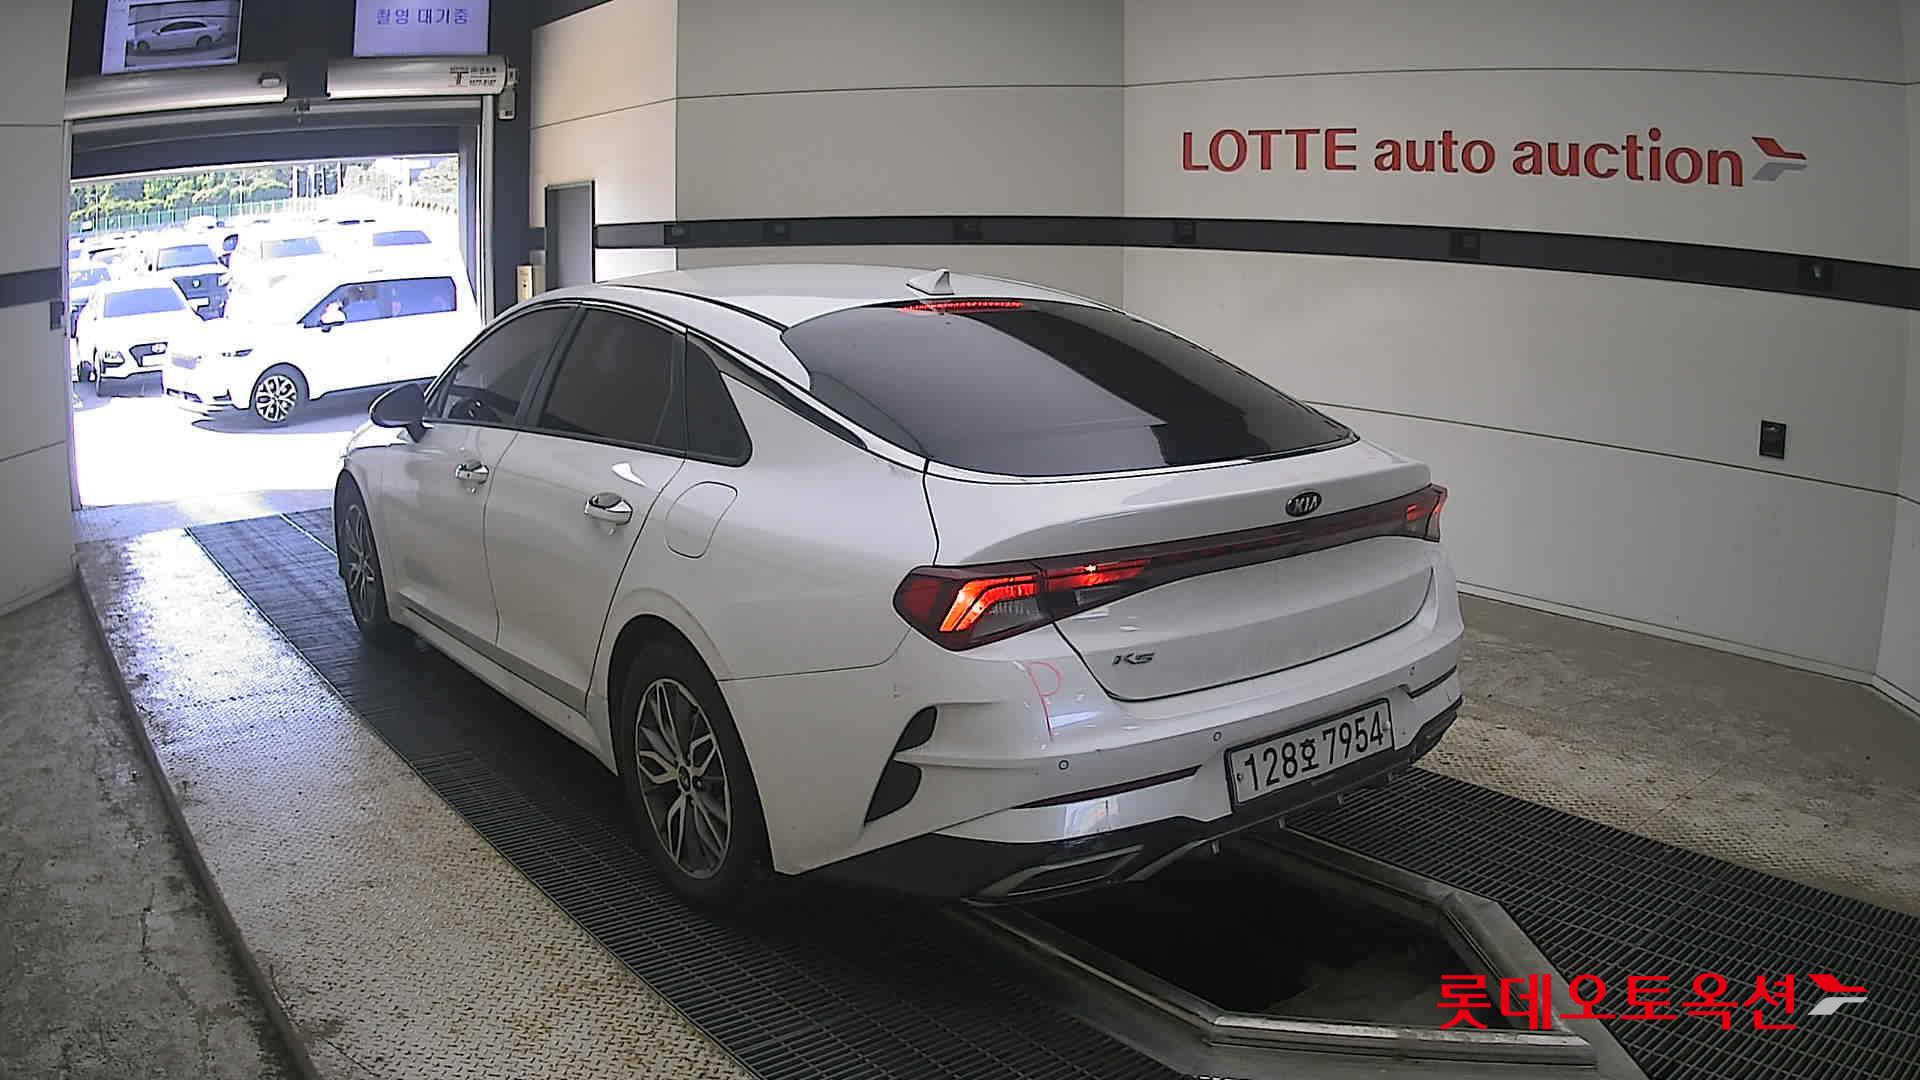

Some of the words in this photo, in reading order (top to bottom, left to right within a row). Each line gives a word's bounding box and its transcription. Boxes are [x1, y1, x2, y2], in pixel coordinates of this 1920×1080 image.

[417, 8, 468, 25] 대기중
[1182, 128, 1357, 172] LOTTE
[1374, 130, 1496, 173] auto
[1512, 127, 1744, 187] auction
[1293, 494, 1319, 513] KIA
[1112, 652, 1155, 666] K5
[1244, 738, 1320, 791] 128호
[1322, 711, 1384, 765] 7954
